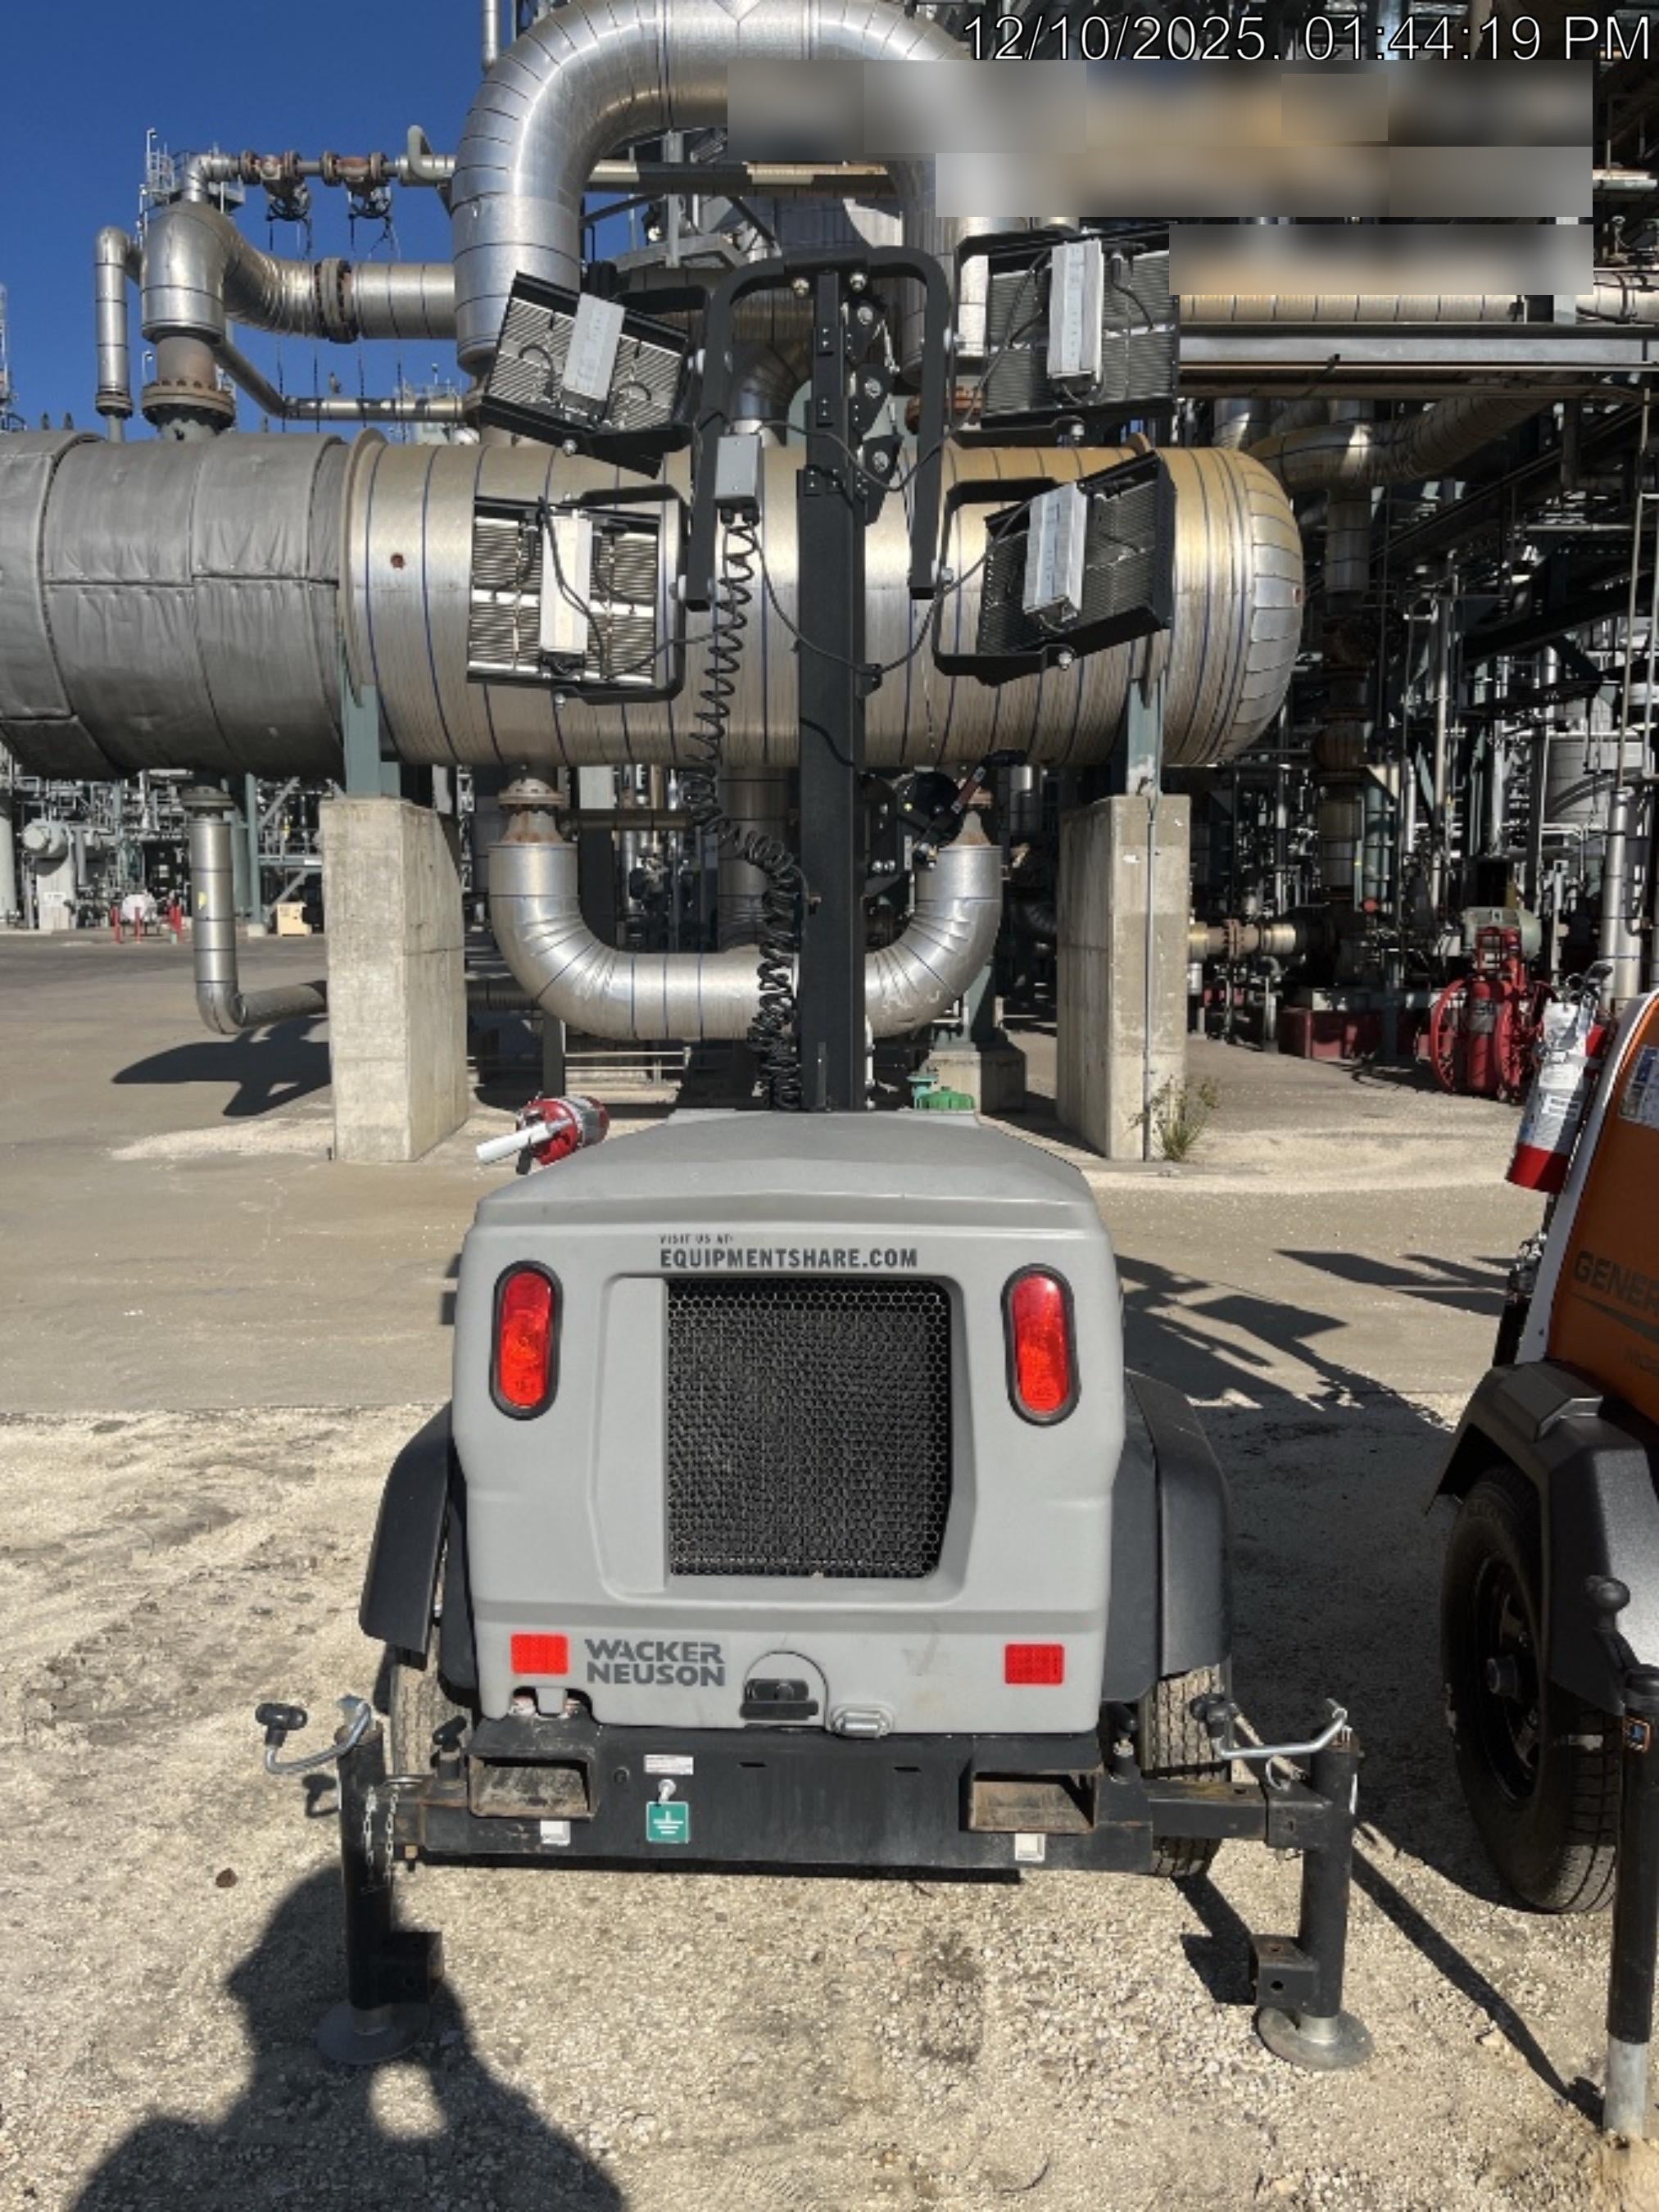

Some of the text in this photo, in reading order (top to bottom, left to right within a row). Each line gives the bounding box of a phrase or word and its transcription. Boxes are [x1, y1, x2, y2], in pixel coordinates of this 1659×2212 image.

[659, 1233, 690, 1244] VISIT
[696, 1233, 710, 1244] US
[660, 1248, 918, 1268] EQUIPMENTSHARE.COM
[584, 1639, 726, 1664] WACKER
[587, 1661, 726, 1687] NEUSON
